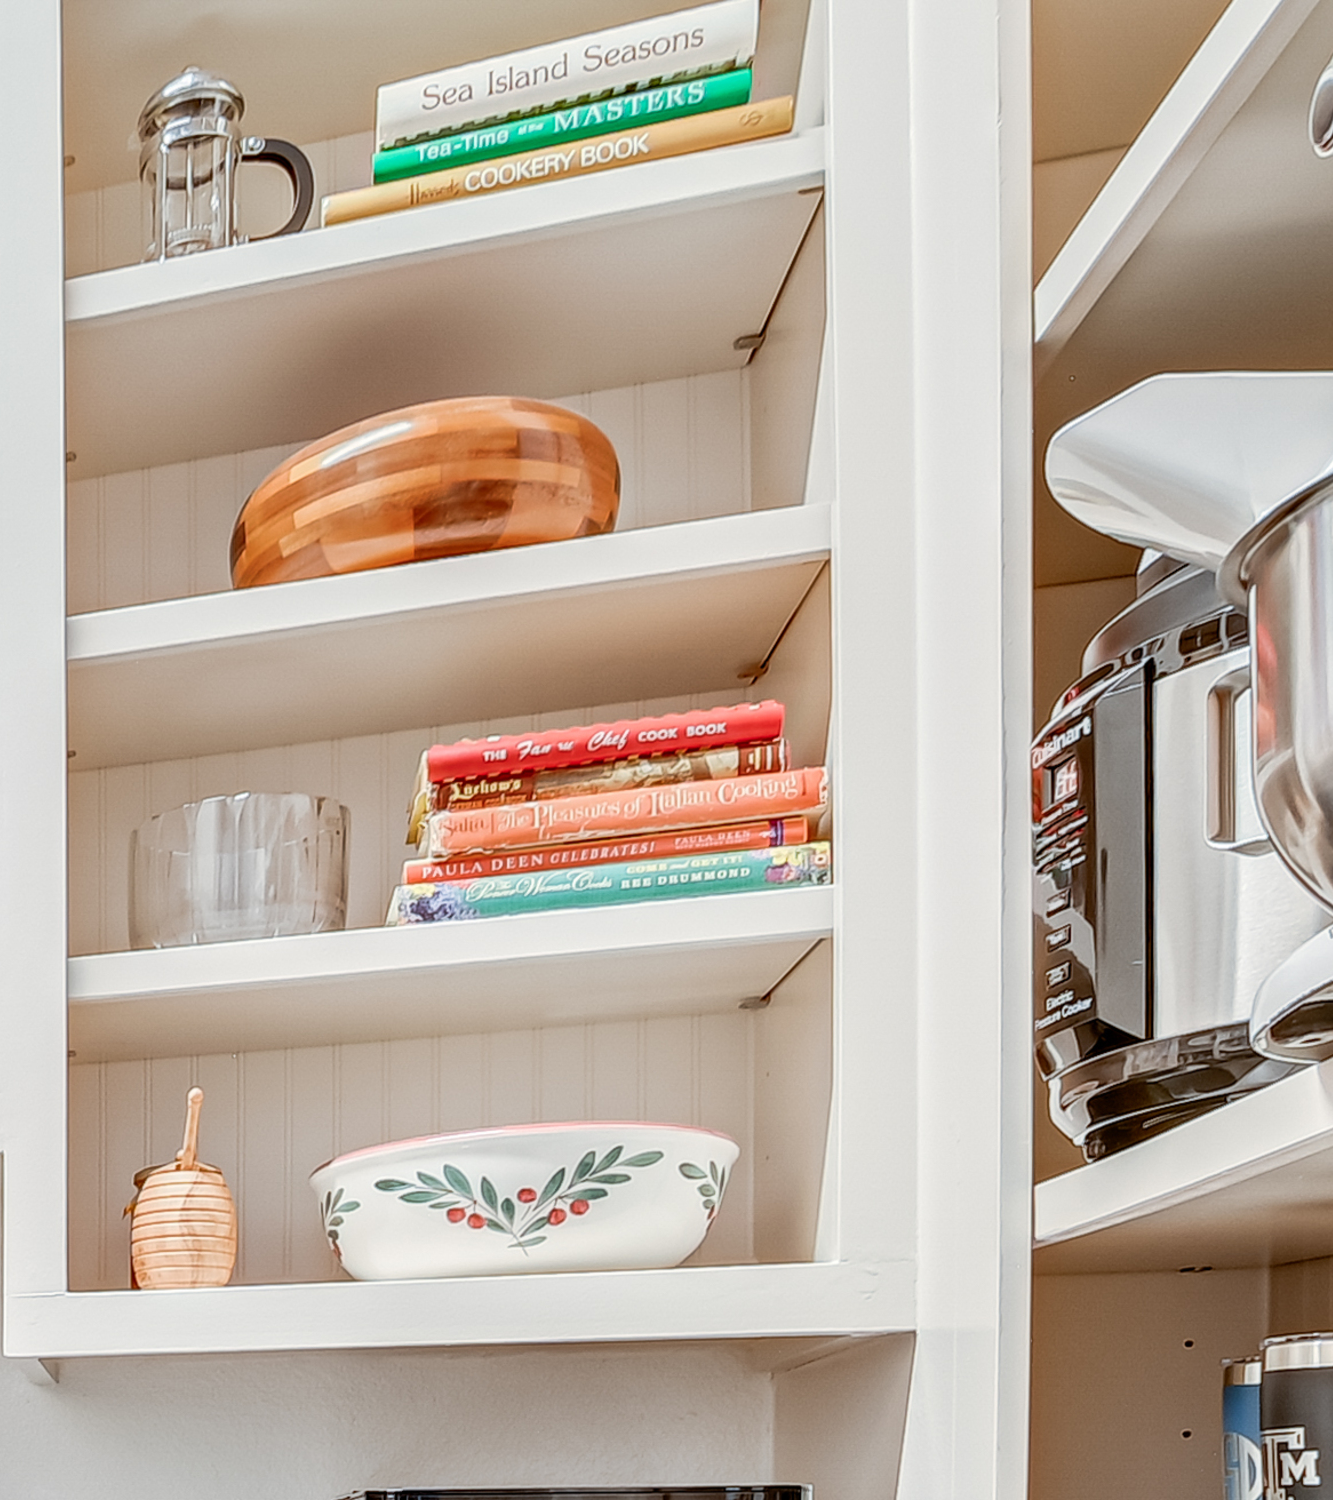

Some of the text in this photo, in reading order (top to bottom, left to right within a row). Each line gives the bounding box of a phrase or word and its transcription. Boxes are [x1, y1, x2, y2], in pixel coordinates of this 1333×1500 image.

[421, 28, 705, 111] Sea Island Seasons
[415, 80, 706, 163] Tea-Time MASTERS
[464, 149, 577, 193] COOKERY
[580, 132, 650, 168] BOOK
[586, 728, 631, 752] Chef
[637, 727, 679, 743] COOK
[686, 721, 728, 738] BOOK
[1031, 715, 1092, 770] Cuisinart
[497, 810, 531, 832] The
[533, 799, 621, 830] Pleasures
[623, 797, 642, 820] of
[648, 785, 713, 817] Italian
[717, 772, 800, 806] Cooking
[421, 841, 657, 879] PAULA DEEN CELEBRATES!
[620, 867, 751, 890] REE DRUMMOND
[626, 861, 668, 875] COME
[690, 855, 720, 868] GET
